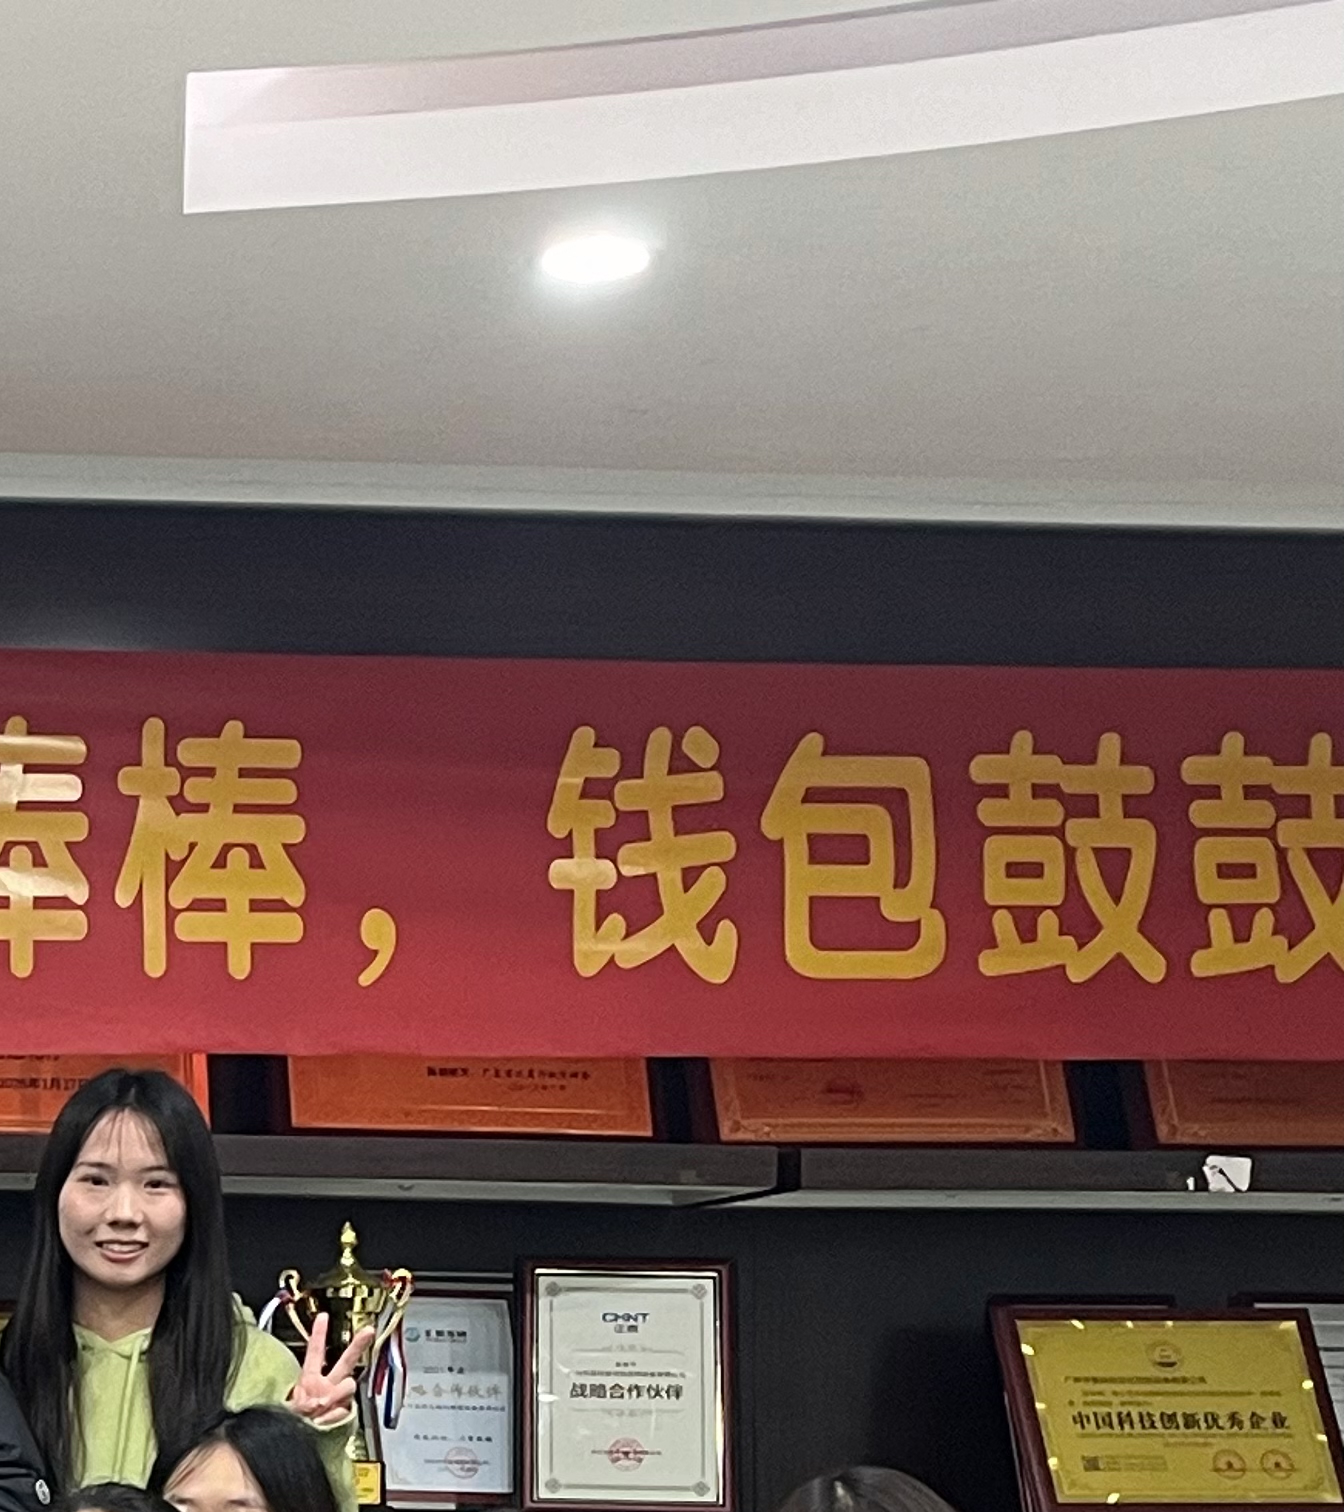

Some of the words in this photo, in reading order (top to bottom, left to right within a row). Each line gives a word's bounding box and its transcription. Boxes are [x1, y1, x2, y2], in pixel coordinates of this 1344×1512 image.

[543, 724, 1344, 986] 钱包鼓鼓
[569, 1382, 684, 1401] 战略合作伙伴
